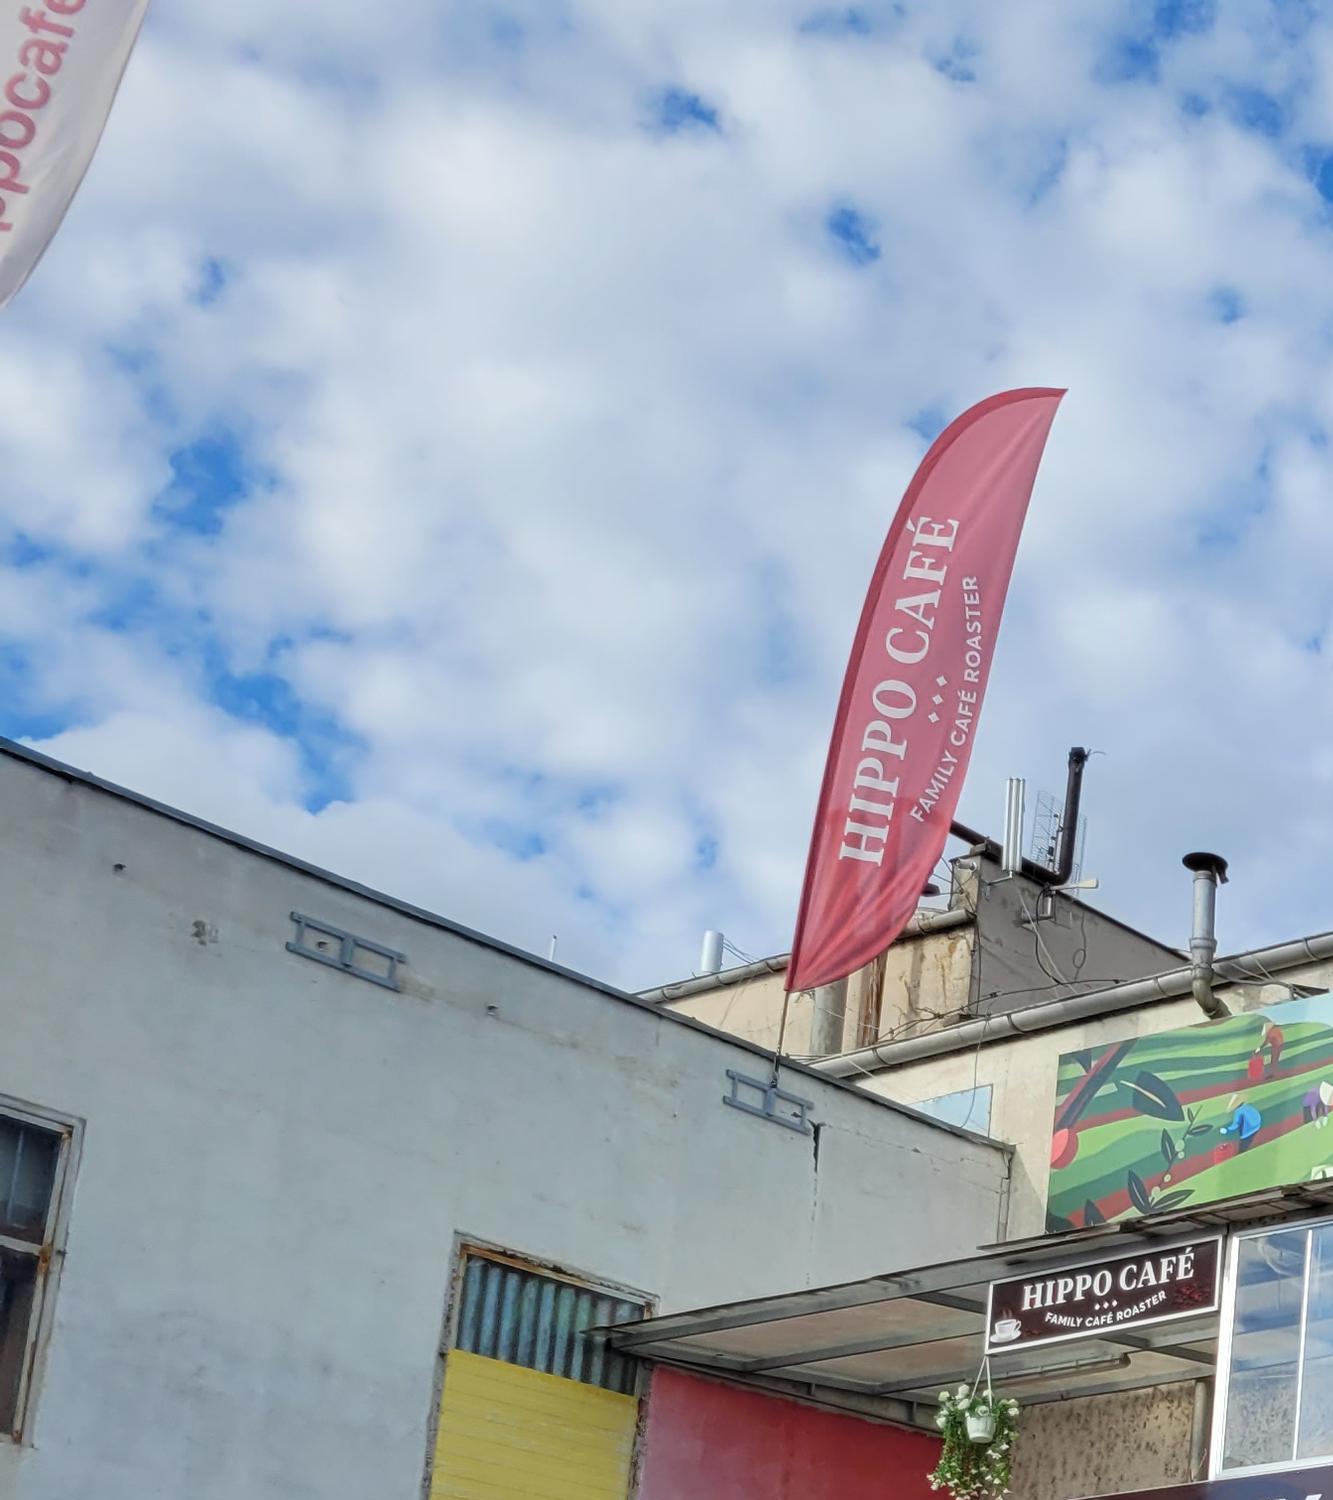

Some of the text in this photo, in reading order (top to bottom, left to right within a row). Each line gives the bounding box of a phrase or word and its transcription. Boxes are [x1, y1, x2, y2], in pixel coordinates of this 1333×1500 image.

[838, 515, 960, 866] HIPPO CAFÉ
[910, 575, 980, 823] FAMILY CAFÉ ROASTER
[1022, 1247, 1196, 1312] HIPPO CAFÉ
[1044, 1290, 1167, 1328] FAMILY CAFÉ ROASTER
